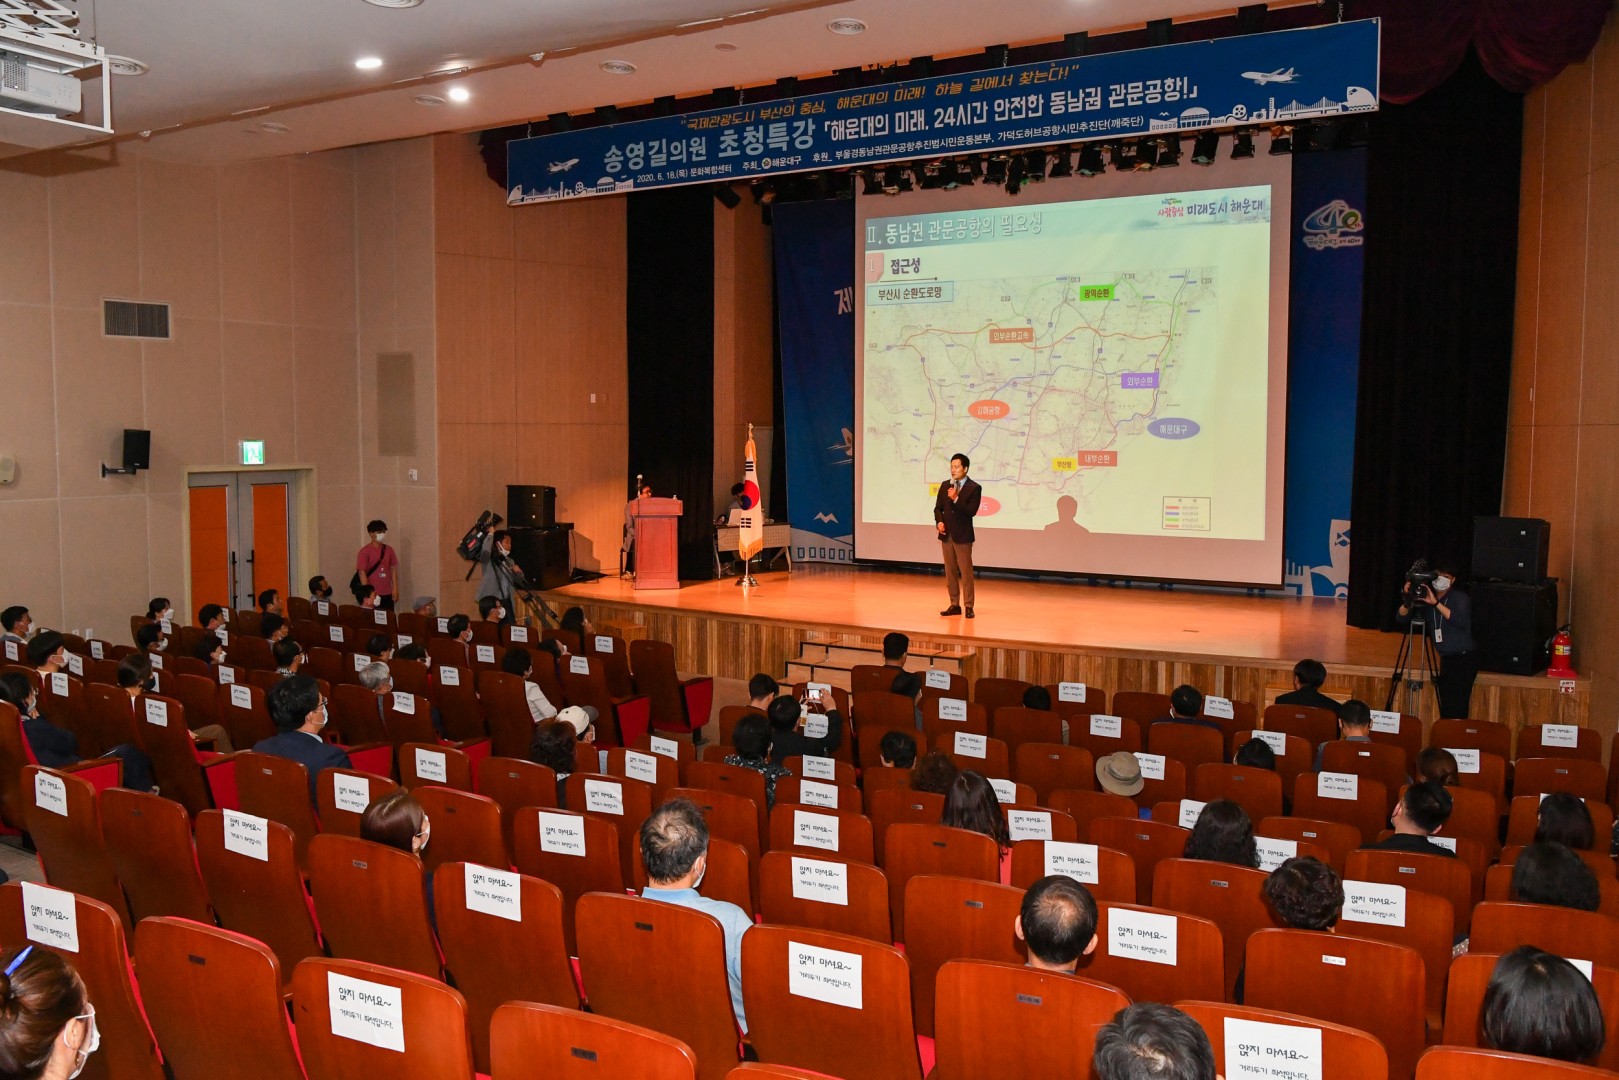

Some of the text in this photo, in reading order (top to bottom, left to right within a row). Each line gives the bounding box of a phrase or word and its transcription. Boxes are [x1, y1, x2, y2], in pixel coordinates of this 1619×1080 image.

[760, 105, 795, 120] 부산의
[837, 91, 889, 110] 해운대의
[894, 86, 926, 102] 미래!
[936, 83, 963, 96] 하늘
[970, 74, 1014, 92] 길에서
[604, 136, 707, 172] 송영길의원
[719, 118, 816, 158] 초청특강
[934, 101, 989, 128] 24시간
[994, 94, 1044, 122] 안전한
[1050, 86, 1102, 115] 동남권
[772, 156, 802, 167] 해운대구
[1187, 202, 1228, 216] 미래도시
[1231, 198, 1263, 215] 해운대
[886, 221, 924, 245] 동남권
[928, 216, 996, 241] 관문공항의
[999, 212, 1043, 237] 필요성
[891, 258, 921, 275] 접근성
[878, 286, 942, 301] 부산시 순환도로망
[1160, 424, 1187, 435] 해운대구
[1085, 454, 1110, 464] 내부순환
